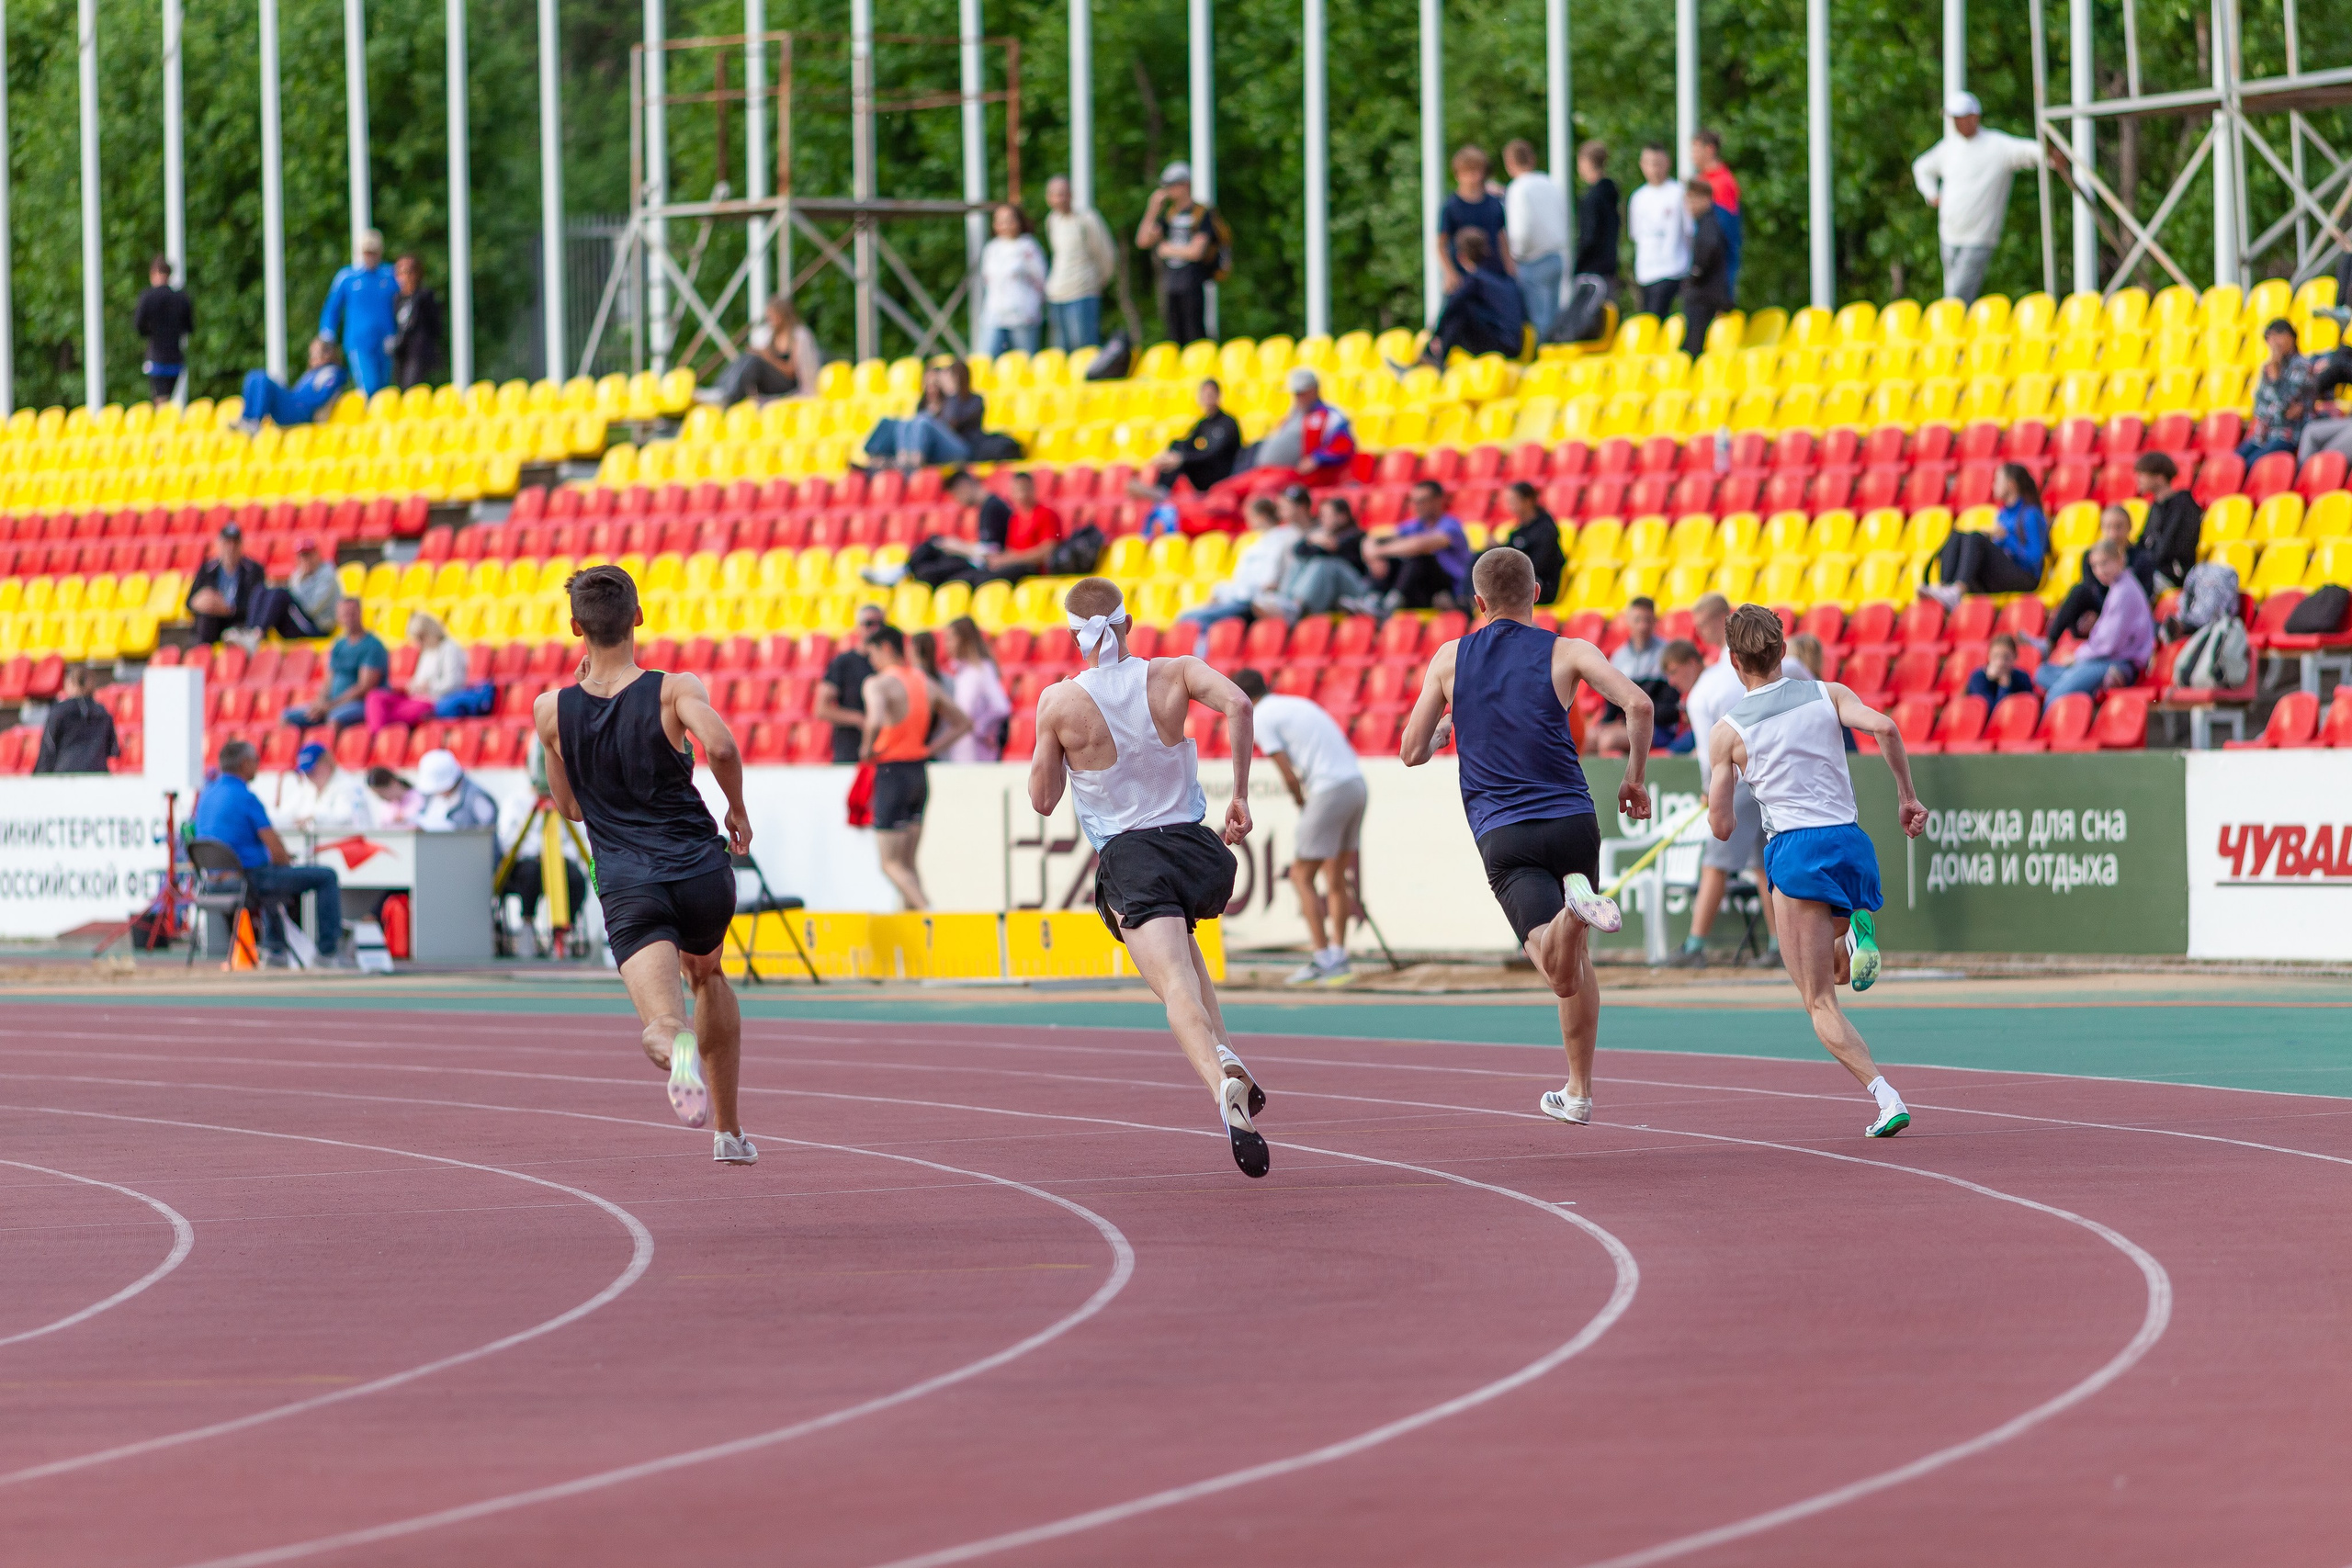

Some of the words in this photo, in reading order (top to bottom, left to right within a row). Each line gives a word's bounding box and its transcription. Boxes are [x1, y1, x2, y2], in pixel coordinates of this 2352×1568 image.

[0, 818, 145, 848] ИНИСТЕРСТВО
[1926, 808, 2024, 850] одежда
[2028, 808, 2076, 851] для
[2081, 808, 2127, 842] сна
[0, 863, 119, 899] ОССИЙСКОЙ
[1927, 852, 1996, 894] дома
[2001, 852, 2019, 886] и
[2025, 852, 2119, 895] отдыха
[922, 919, 933, 949] 7
